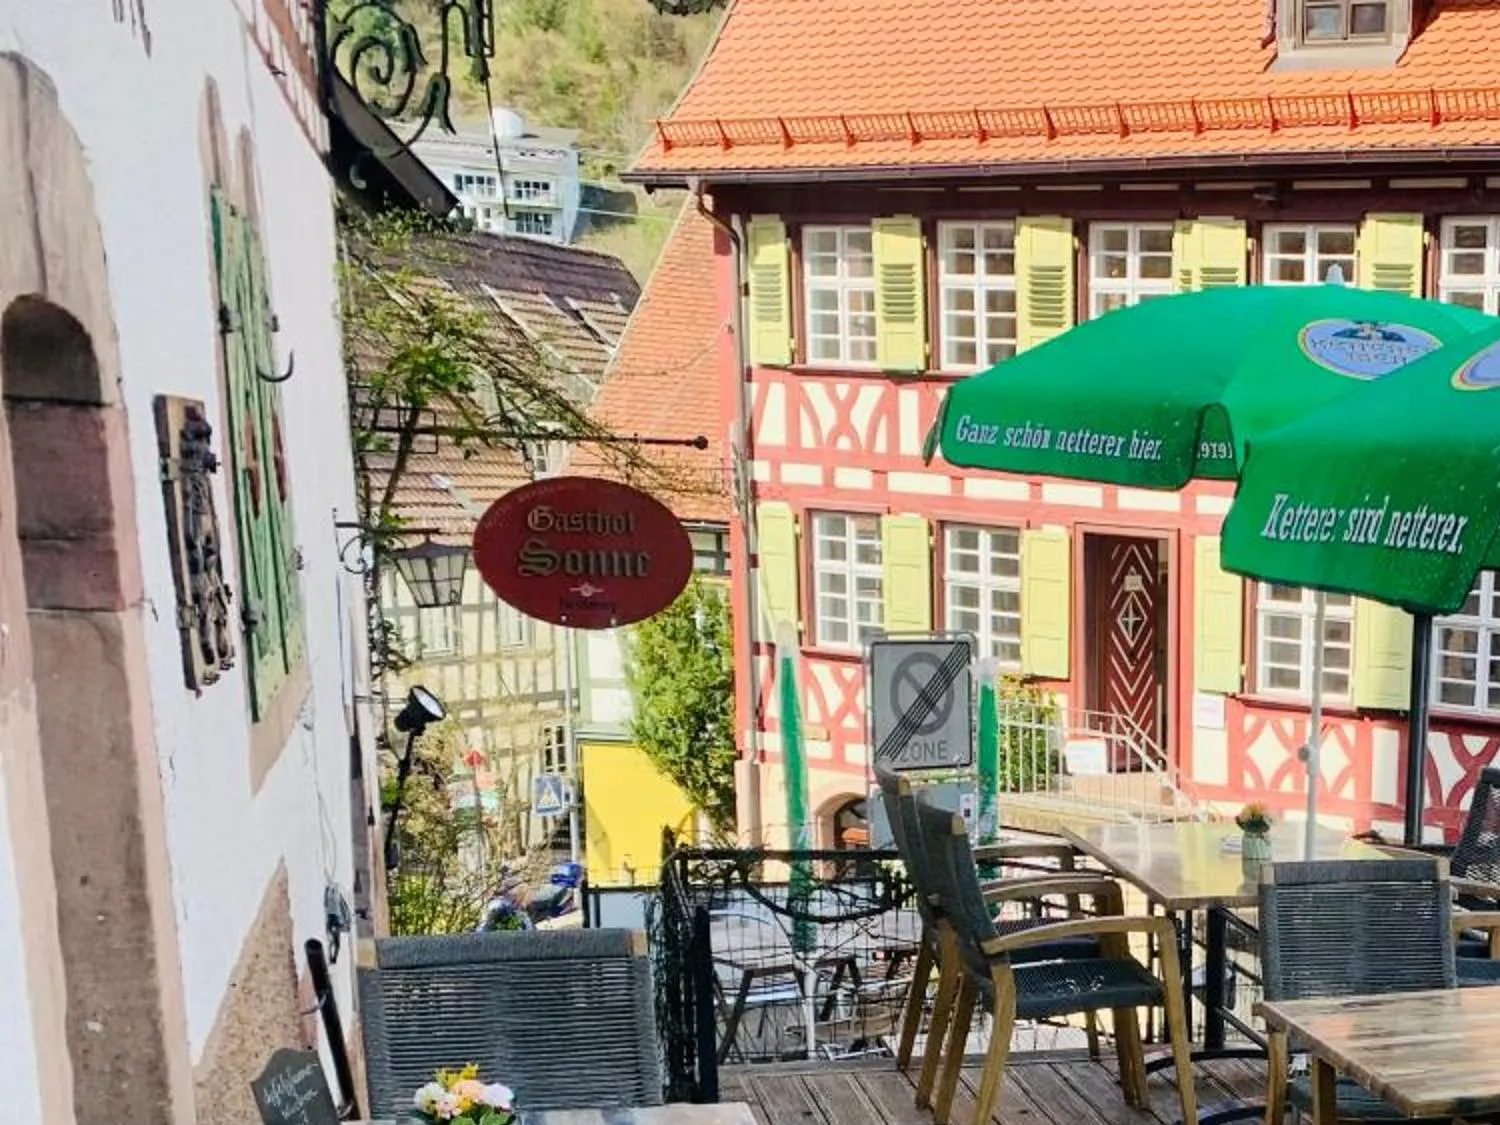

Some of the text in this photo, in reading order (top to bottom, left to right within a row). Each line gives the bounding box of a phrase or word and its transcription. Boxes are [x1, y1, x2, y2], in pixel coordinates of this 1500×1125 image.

[956, 415, 1163, 461] Ganz schön netterer hier.
[1343, 495, 1391, 545] sind
[1383, 503, 1468, 555] netterer.
[516, 536, 650, 578] Sonne
[898, 740, 949, 763] ZONE
